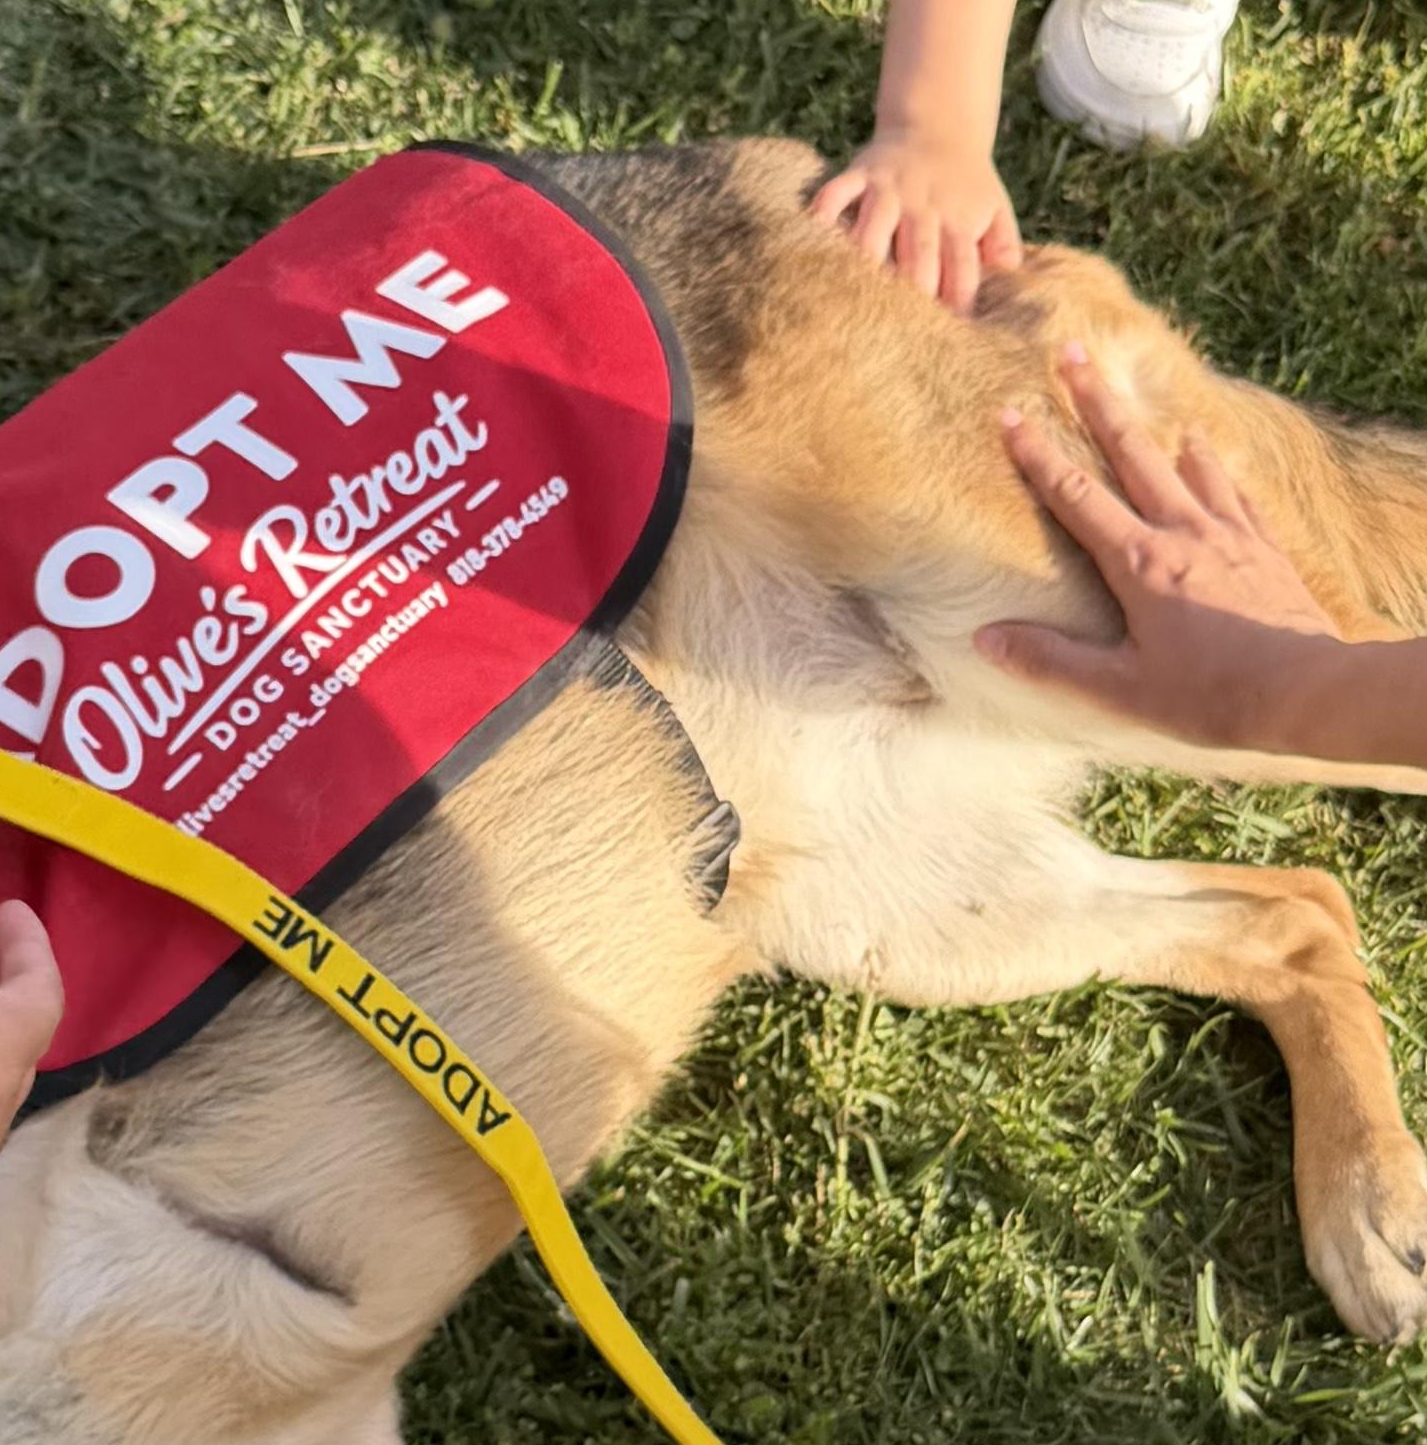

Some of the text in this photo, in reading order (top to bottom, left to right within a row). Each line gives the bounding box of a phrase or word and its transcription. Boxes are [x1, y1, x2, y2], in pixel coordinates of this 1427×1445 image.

[282, 249, 510, 427] ME
[61, 391, 489, 793] Olive's Retreat
[176, 475, 569, 838] livesretreat_dogsanctuary 818-378-4549
[203, 510, 461, 752] DOG SANCTUARY
[252, 894, 512, 1136] ADOPT ME
